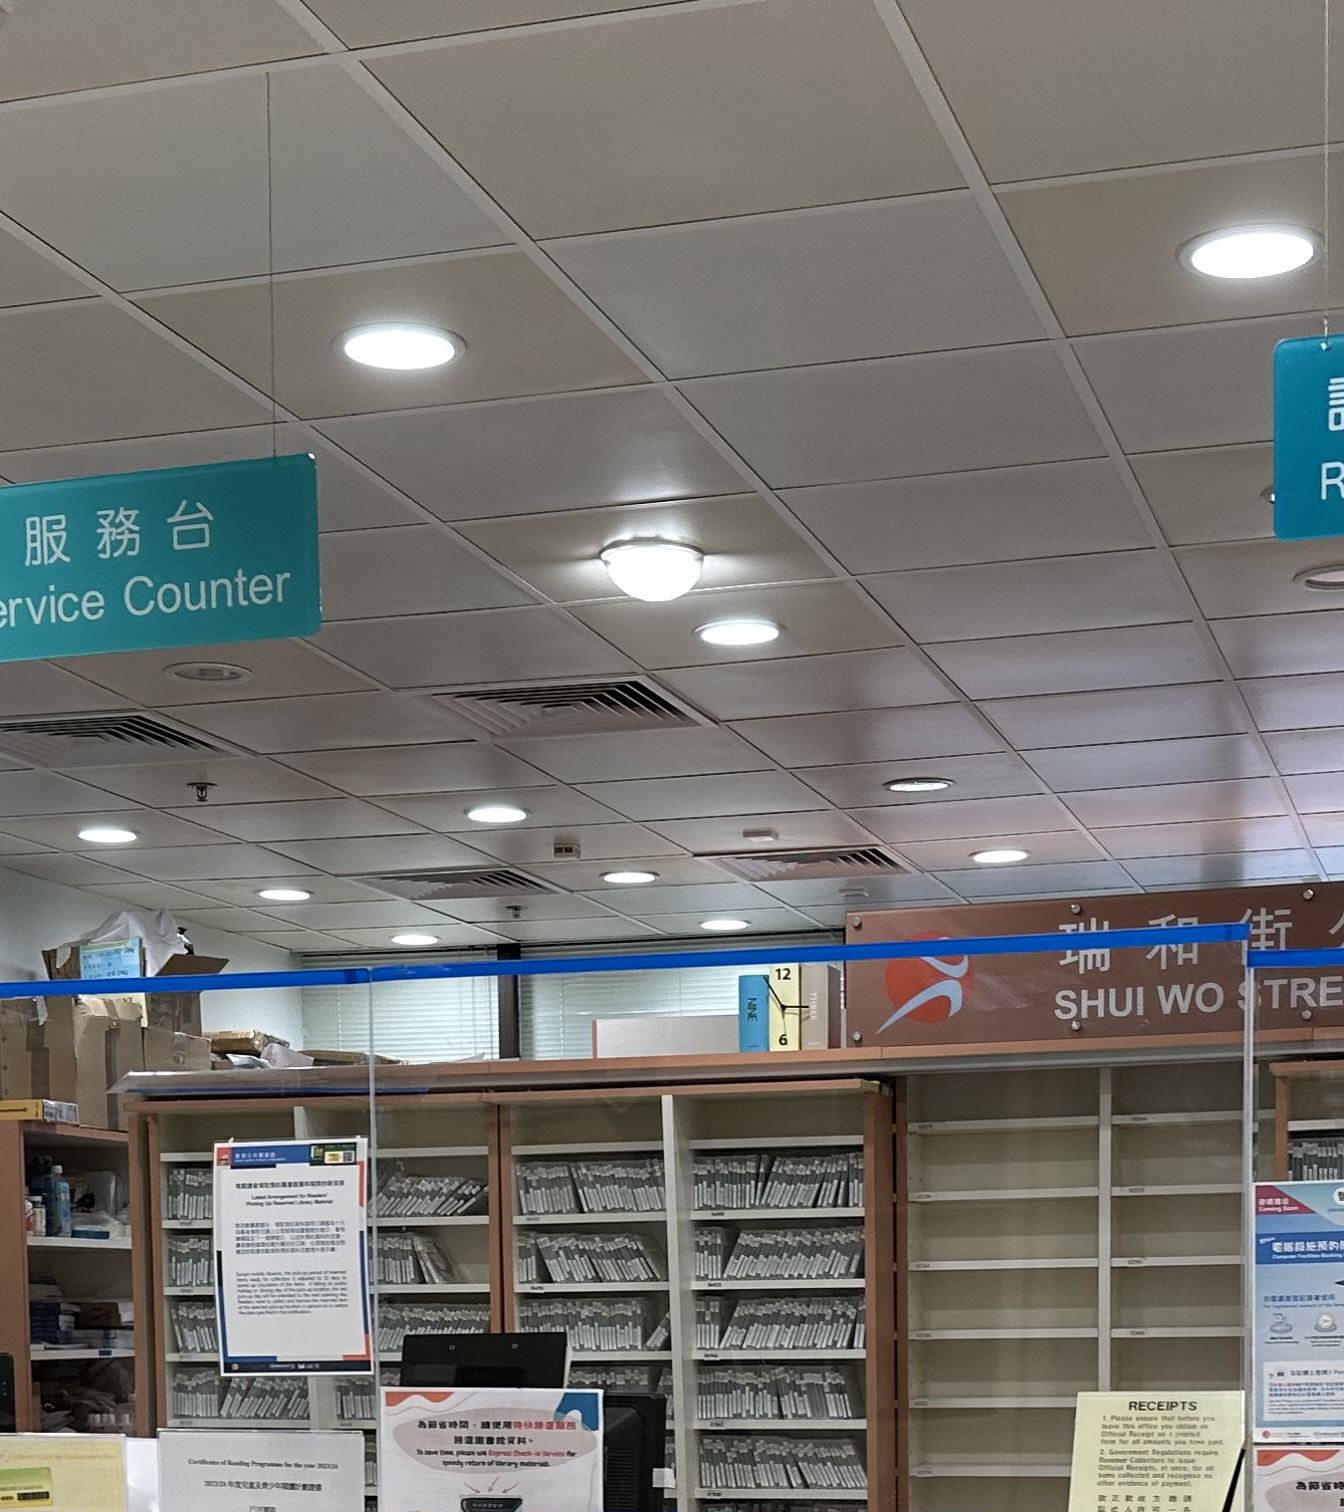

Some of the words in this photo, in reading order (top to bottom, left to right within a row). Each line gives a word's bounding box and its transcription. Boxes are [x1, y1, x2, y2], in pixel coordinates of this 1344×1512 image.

[24, 500, 215, 566] 服務台
[124, 567, 291, 617] Counter
[774, 968, 791, 981] 12
[1054, 986, 1144, 1021] SHUI
[1157, 982, 1224, 1014] WO
[778, 1035, 788, 1046] 6
[1128, 1401, 1198, 1411] RECEIPTS
